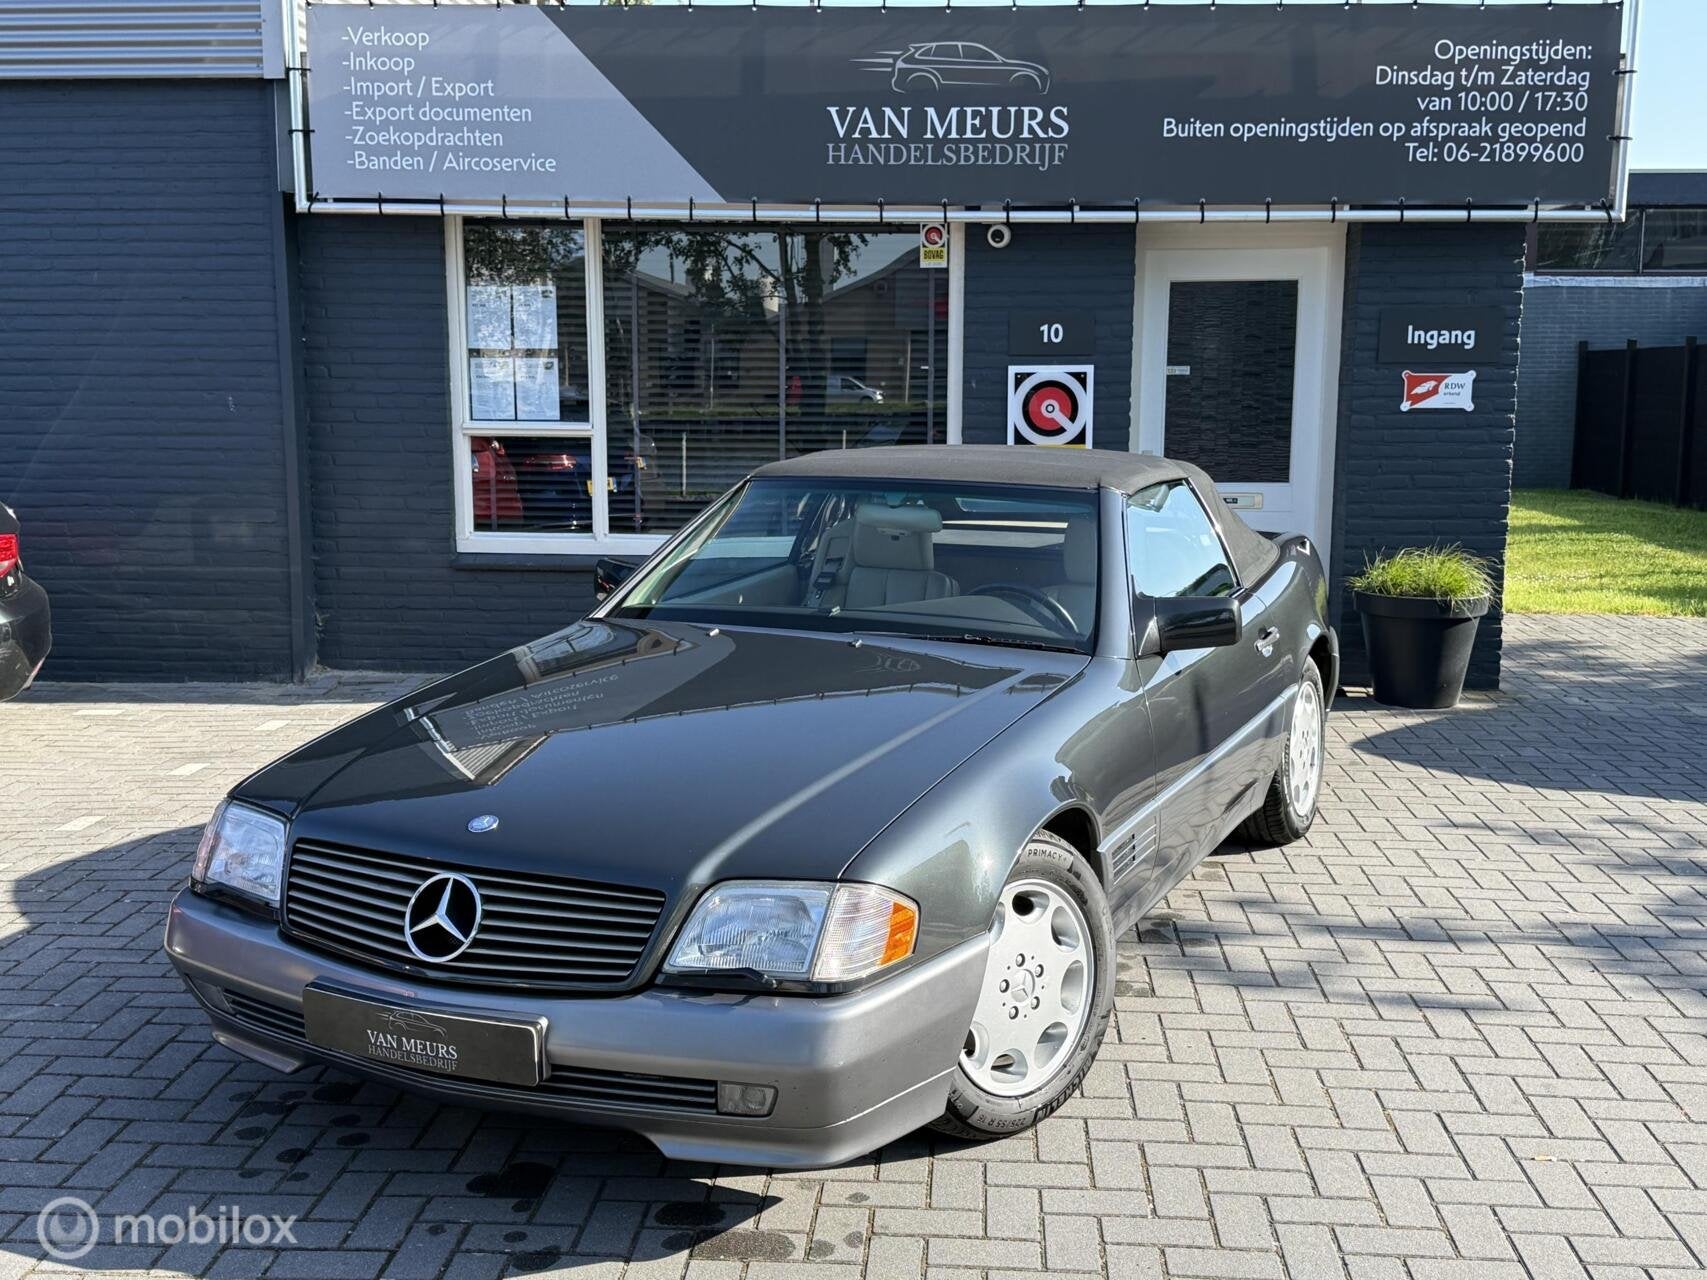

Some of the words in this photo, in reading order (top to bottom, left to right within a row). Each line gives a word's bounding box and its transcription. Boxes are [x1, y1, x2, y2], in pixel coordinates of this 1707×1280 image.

[341, 26, 430, 50] -Verkoop
[342, 51, 415, 75] -Inkoop
[1434, 38, 1593, 66] Openingstijden:
[343, 76, 413, 100] -Import
[416, 75, 426, 98] /
[431, 78, 495, 101] Export
[1375, 64, 1455, 90] Dinsdag
[1459, 64, 1495, 88] t/m
[1500, 65, 1591, 91] Zaterdag
[344, 101, 415, 125] -Export
[418, 102, 532, 122] documenten
[1416, 96, 1452, 112] van
[1457, 90, 1514, 112] 10:00
[1518, 90, 1530, 113] /
[1534, 91, 1588, 112] 17:30
[826, 106, 912, 139] VAN
[922, 106, 1070, 139] MEURS
[1163, 117, 1225, 138] Buiten
[1229, 117, 1374, 142] openingstijden
[1379, 122, 1406, 142] op
[1410, 117, 1493, 142] afspraak
[1497, 117, 1587, 141] geopend
[345, 126, 504, 150] -Zoekopdrachten
[347, 150, 424, 171] -Banden
[428, 150, 438, 173] /
[442, 151, 557, 173] Aircoservice
[825, 143, 1069, 171] HANDELSBEDRIJF
[1404, 142, 1439, 163] Tel:
[1443, 142, 1585, 163] 06-21899600
[1038, 322, 1065, 344] 10
[1406, 324, 1477, 350] Ingang
[1443, 382, 1466, 391] RDW
[1027, 848, 1063, 860] PRIMACY
[366, 1029, 398, 1049] VAN
[401, 1037, 458, 1060] MEURS
[367, 1044, 459, 1072] HANDELSBEDRIJF
